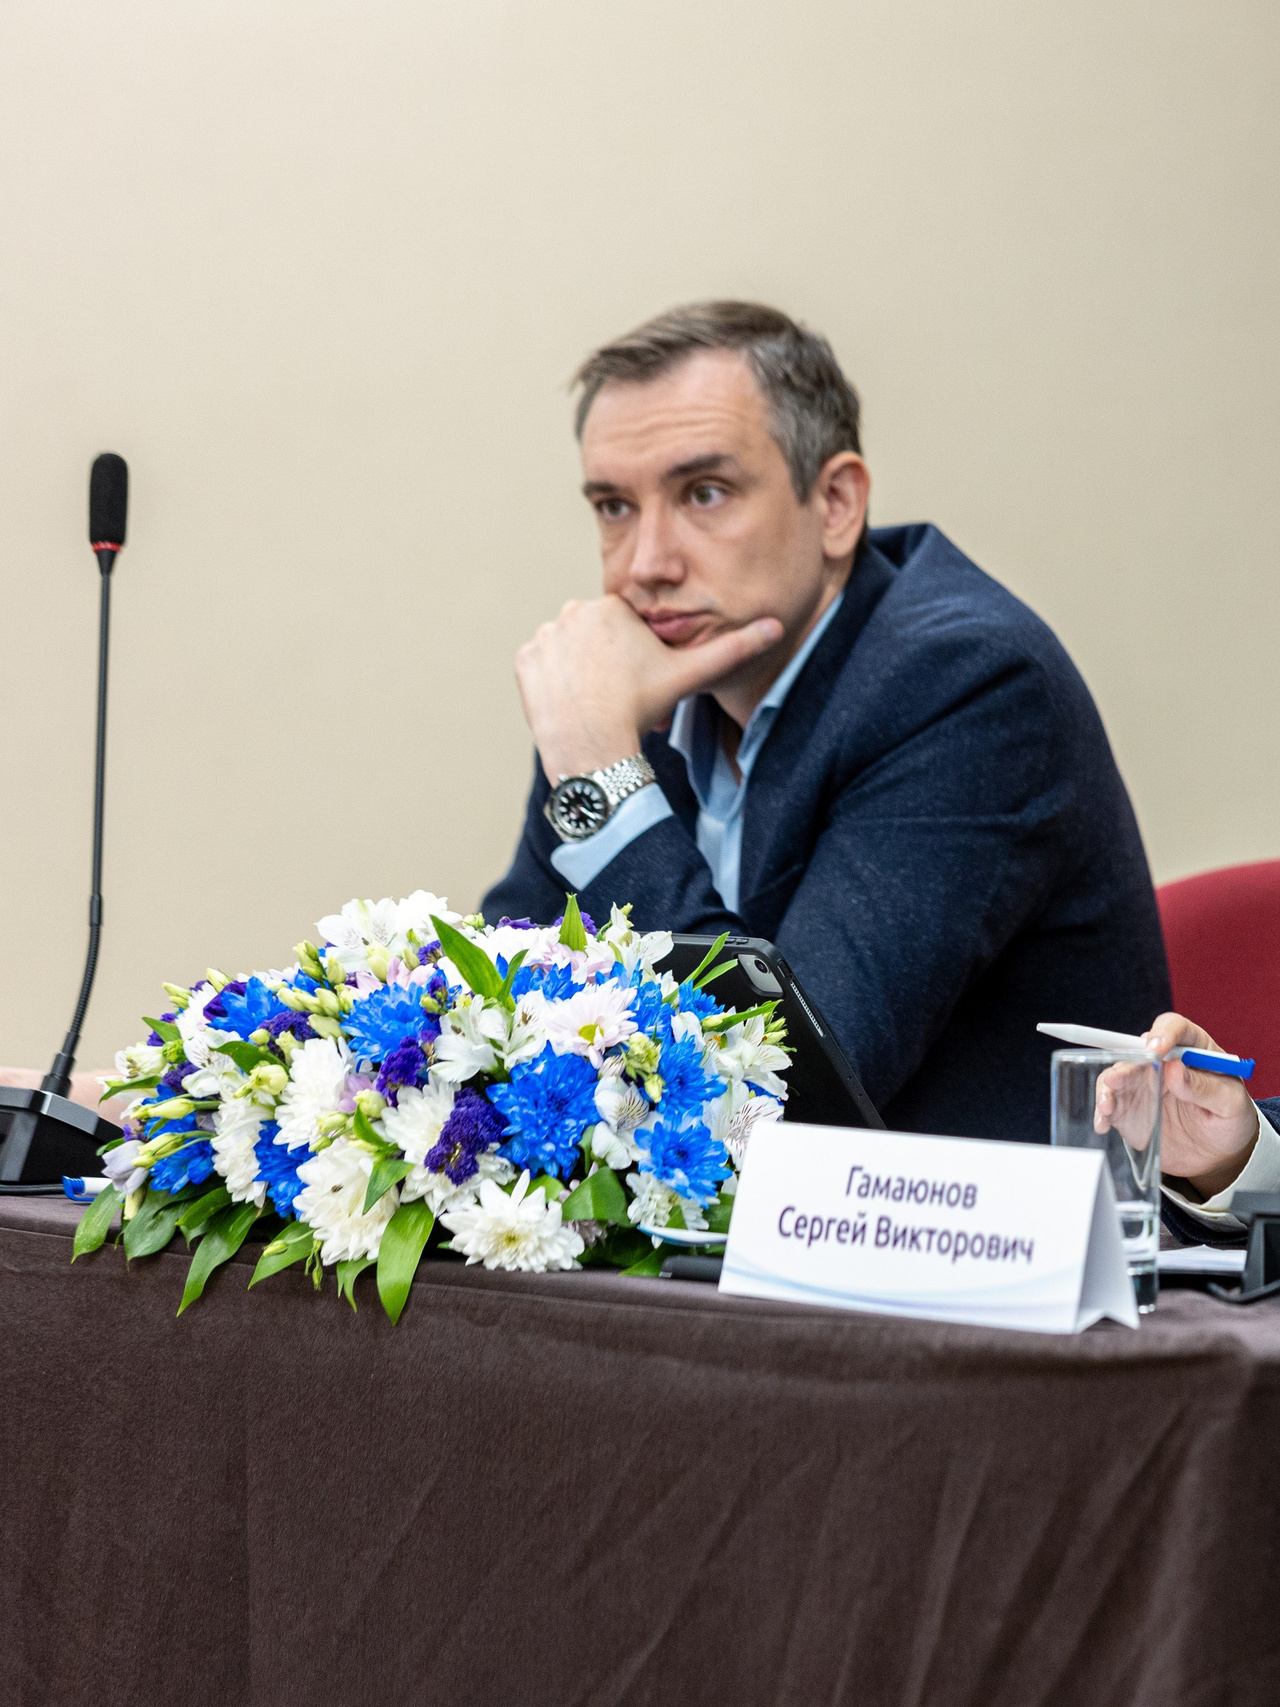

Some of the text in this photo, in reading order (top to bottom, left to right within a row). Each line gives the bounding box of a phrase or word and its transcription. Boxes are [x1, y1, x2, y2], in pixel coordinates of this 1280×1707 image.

[845, 1164, 978, 1210] Гамаюнов
[777, 1205, 1036, 1265] Сергей Викторович
